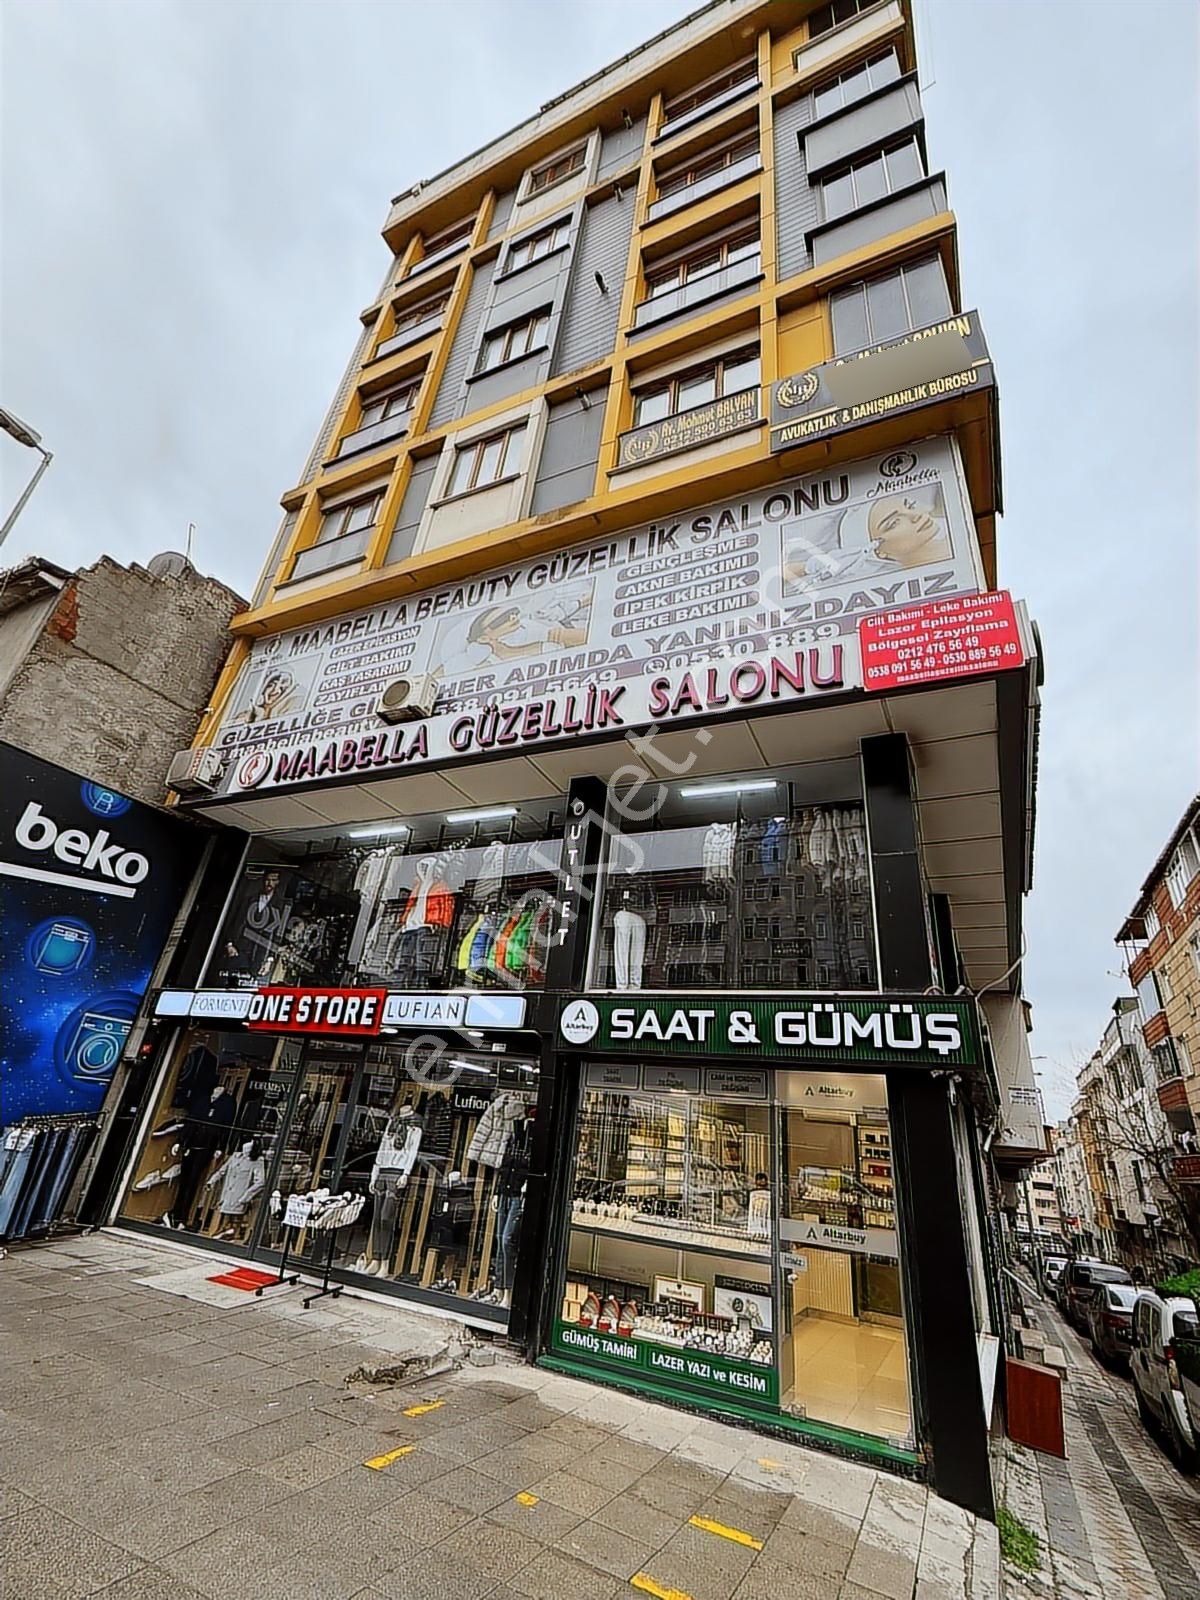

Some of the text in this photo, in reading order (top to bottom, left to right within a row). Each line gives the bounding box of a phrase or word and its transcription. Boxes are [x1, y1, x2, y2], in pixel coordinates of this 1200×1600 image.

[716, 391, 756, 419] BALYAN
[780, 414, 837, 443] AVUKATLIK
[841, 410, 851, 424] &
[852, 387, 929, 419] DANIŞMANLIK
[663, 430, 692, 446] 0212
[289, 474, 851, 657] MAABELLA BEAUTY GÜZELLİK SALONU
[626, 536, 748, 577] GENÇLEŞME
[624, 555, 748, 597] AKNE BAKIMI
[623, 574, 747, 615] İPEK KİRPİK
[621, 594, 748, 634] LEKE BAKIMI
[878, 608, 994, 637] Lazer Epilasyon
[933, 619, 1009, 640] Zayıflama
[437, 570, 958, 699] HER ADIMDA YANINIZDAYIZ
[768, 621, 841, 648] 889
[897, 636, 979, 660] 0212 476 56 49
[347, 661, 410, 683] TASARIMI
[359, 645, 415, 667] BAKIMI
[867, 664, 890, 678] 0538
[891, 661, 908, 674] 091
[942, 652, 967, 665] 0530
[989, 645, 1002, 657] 56
[1003, 643, 1017, 655] 49
[271, 645, 845, 784] MAABELLA GÜZELLİK SALONU
[14, 801, 150, 885] beko
[558, 799, 584, 947] OUTLET
[247, 994, 375, 1026] ONE STORE
[386, 996, 460, 1021] LUFIAN
[609, 1003, 962, 1055] SAAT & GÜMÜŞ
[454, 1093, 490, 1110] Lufian
[822, 1227, 867, 1244] Altarbuy
[561, 1330, 638, 1361] GÜMÜŞ TAMİRİ
[651, 1351, 767, 1393] LAZER YAZI ve KESİM
